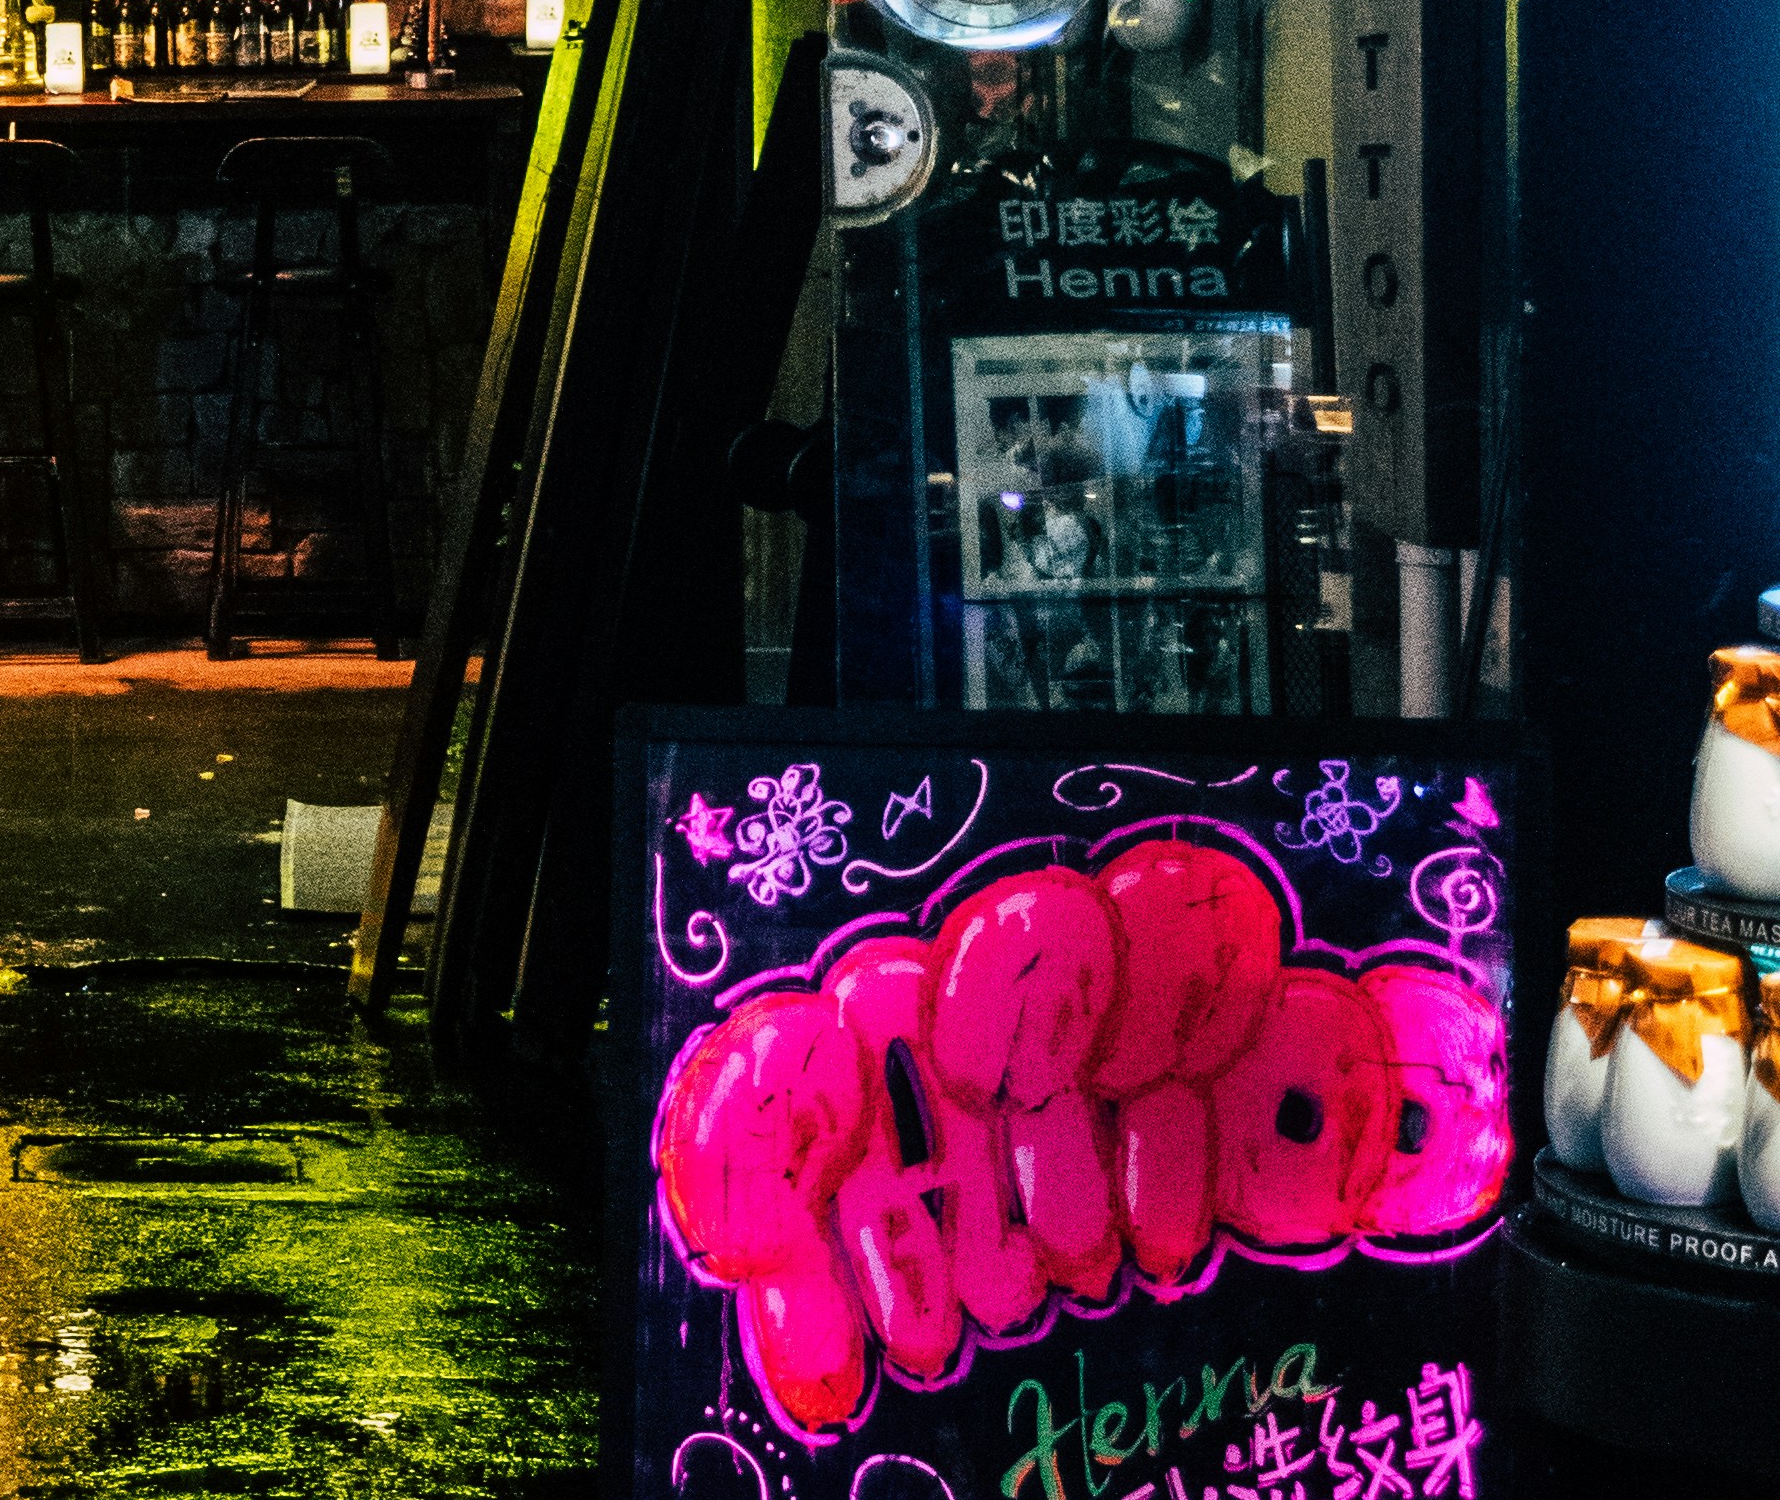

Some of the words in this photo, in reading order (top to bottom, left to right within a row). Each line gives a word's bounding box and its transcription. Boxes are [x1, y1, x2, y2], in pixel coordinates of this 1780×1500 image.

[998, 198, 1220, 250] 印度彩绘
[1003, 258, 1229, 299] Henna
[1572, 1206, 1660, 1249] MOISTURE
